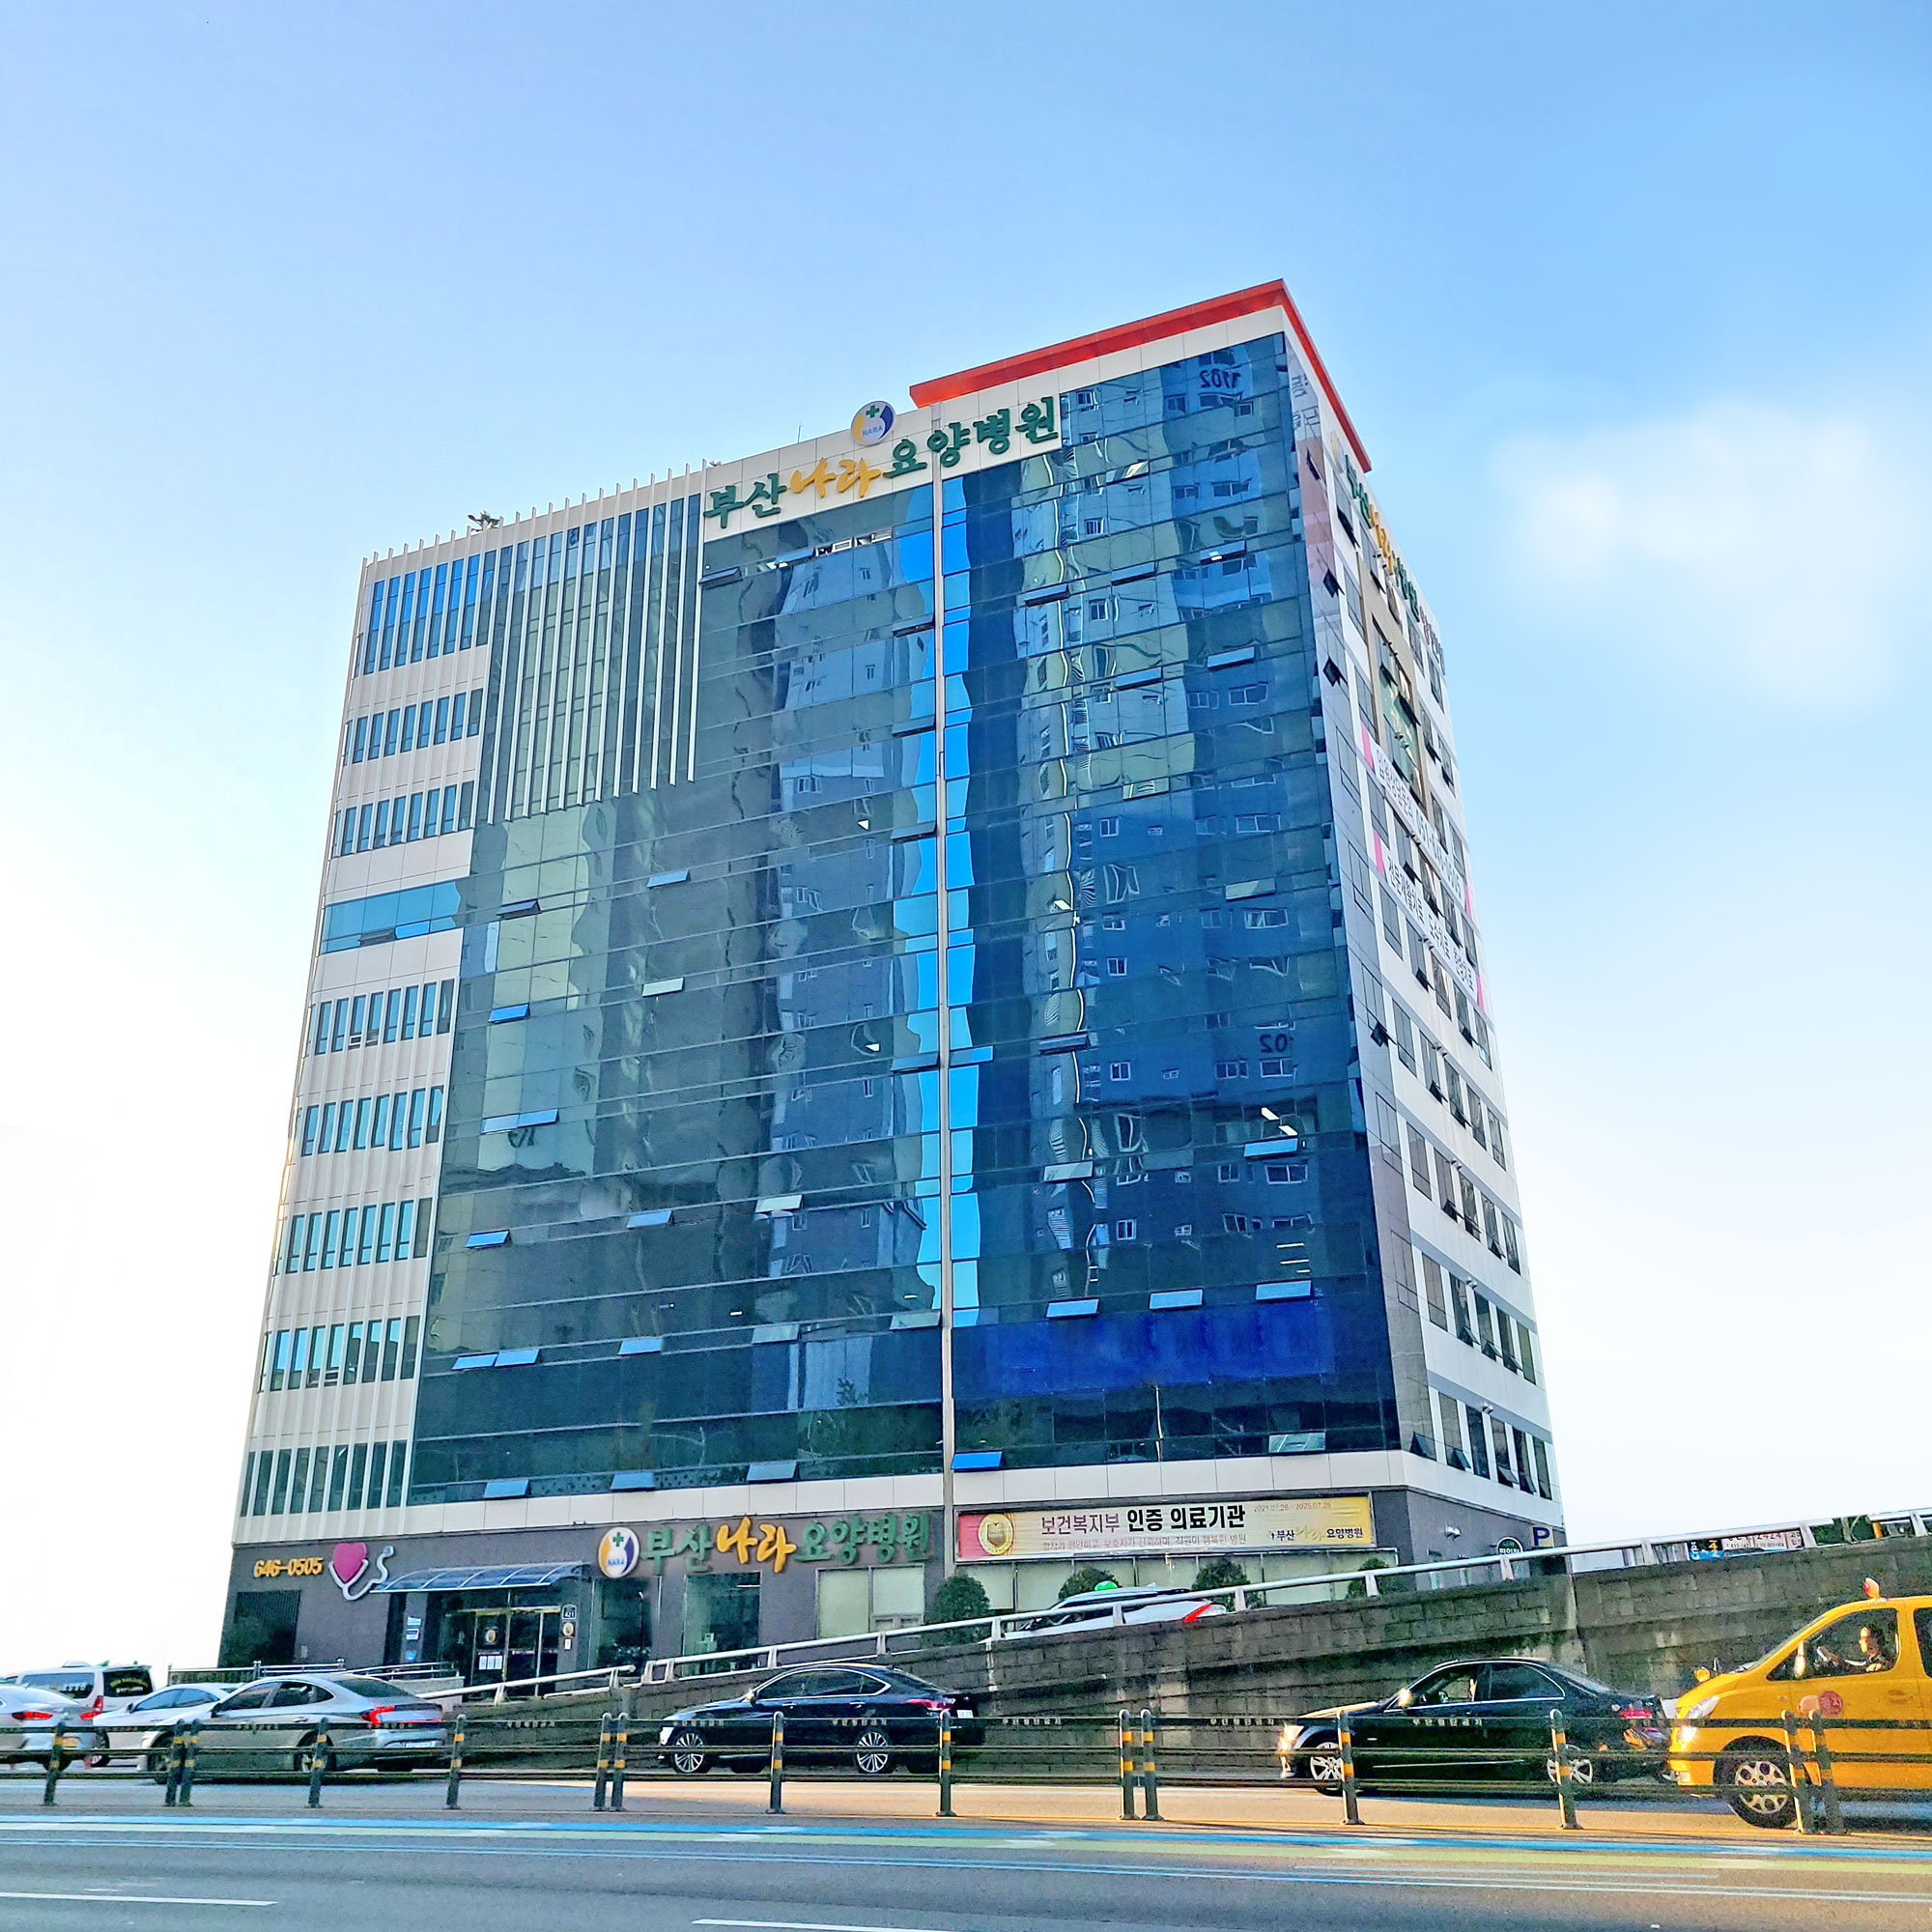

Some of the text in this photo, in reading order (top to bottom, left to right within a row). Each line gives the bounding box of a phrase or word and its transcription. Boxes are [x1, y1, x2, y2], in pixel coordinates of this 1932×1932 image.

[862, 425, 883, 436] NARA
[1041, 1505, 1246, 1535] 보건복지부 인증 의료기관
[1533, 1527, 1550, 1547] P
[254, 1556, 325, 1578] 646-0505
